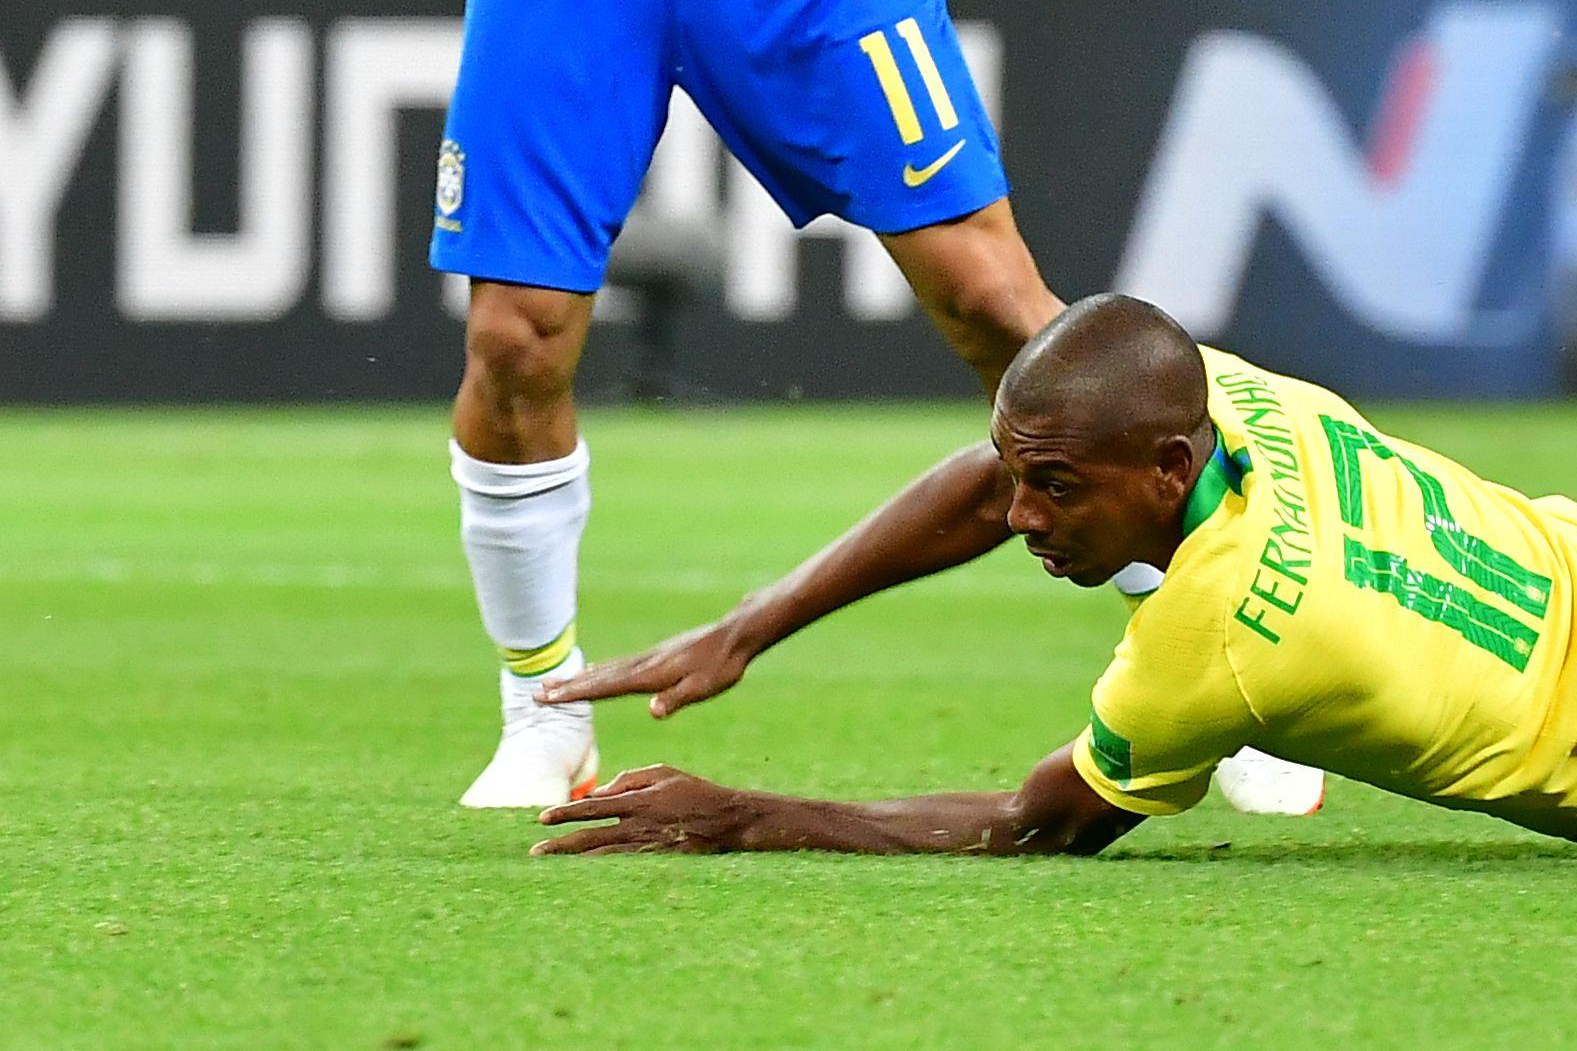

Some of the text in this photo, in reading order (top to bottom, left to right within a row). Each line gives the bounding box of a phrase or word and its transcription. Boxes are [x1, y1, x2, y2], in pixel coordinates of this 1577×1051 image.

[858, 17, 959, 145] 11
[1215, 371, 1313, 645] FERNANDINHO
[1319, 414, 1553, 675] 17
